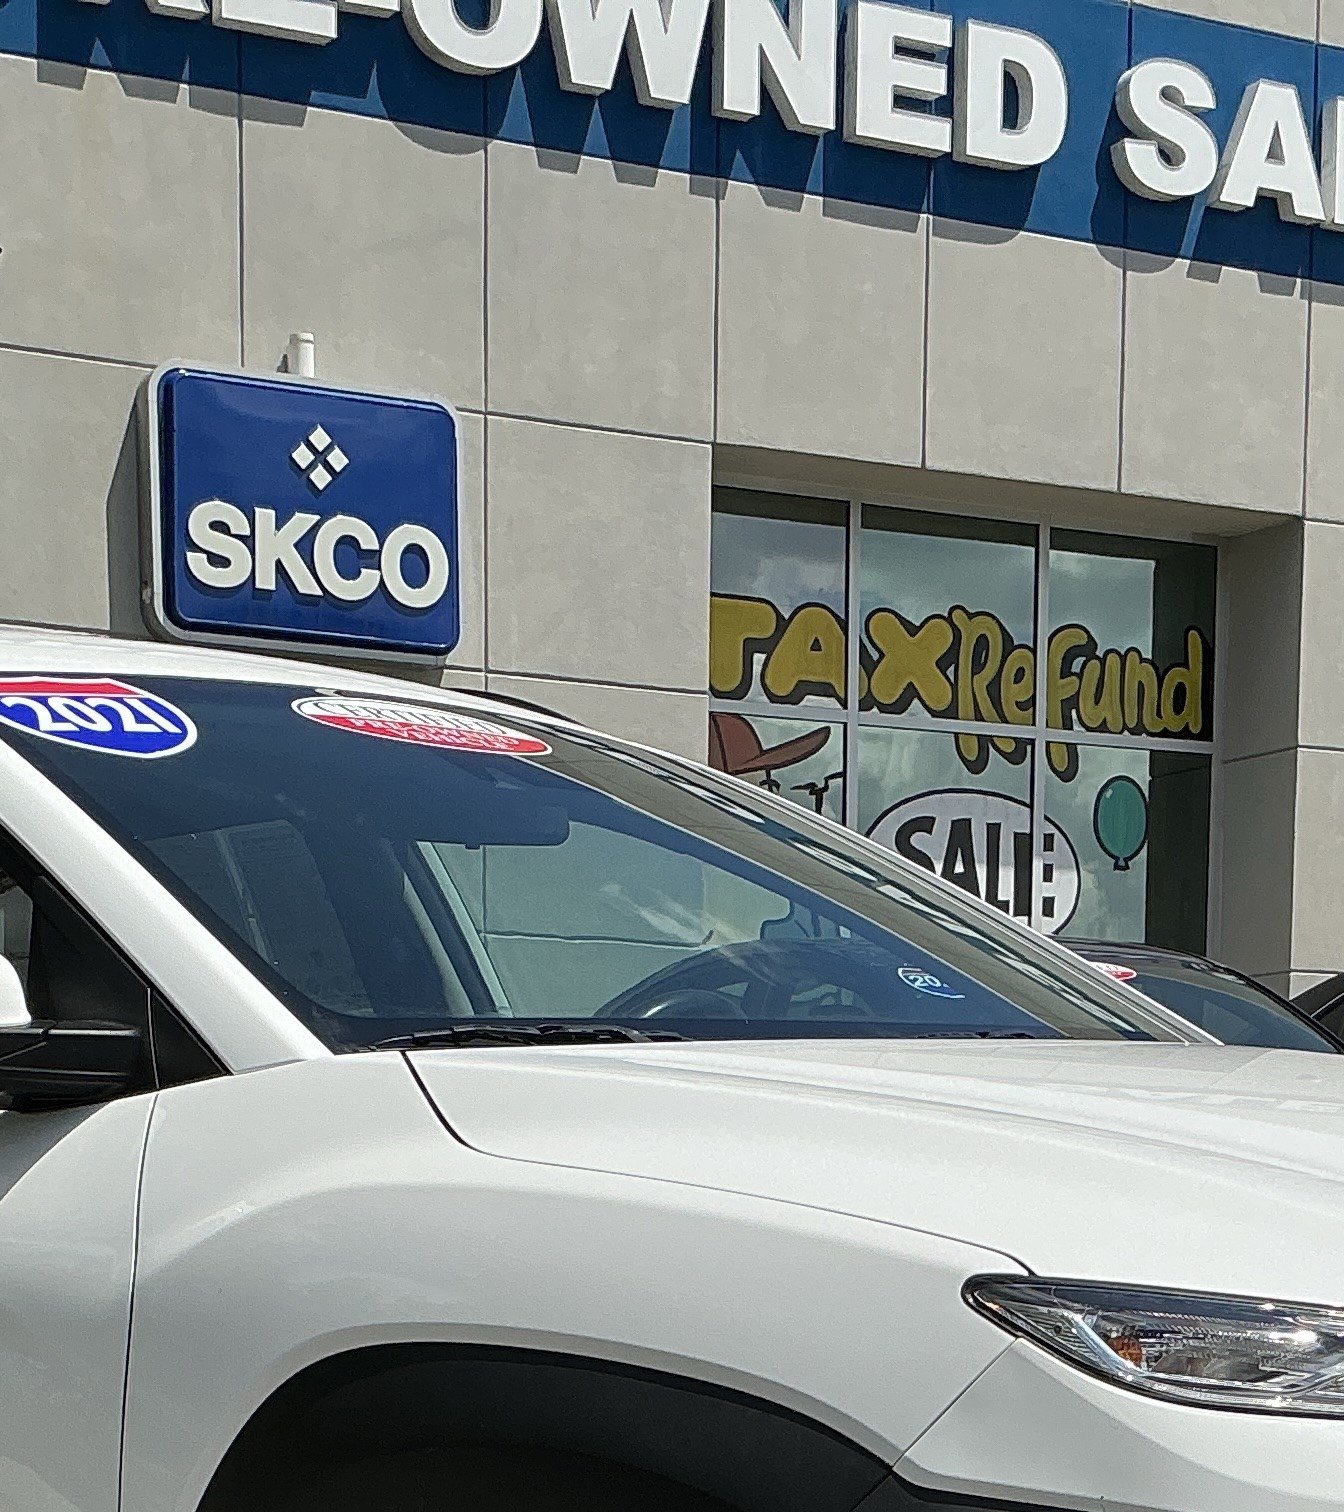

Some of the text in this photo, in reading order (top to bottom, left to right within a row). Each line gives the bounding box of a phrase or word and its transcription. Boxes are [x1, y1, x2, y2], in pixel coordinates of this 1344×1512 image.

[185, 500, 450, 610] SKCO
[709, 592, 954, 720] TAX
[0, 695, 183, 733] 2021
[894, 813, 1055, 920] SALE
[909, 974, 950, 988] 20
